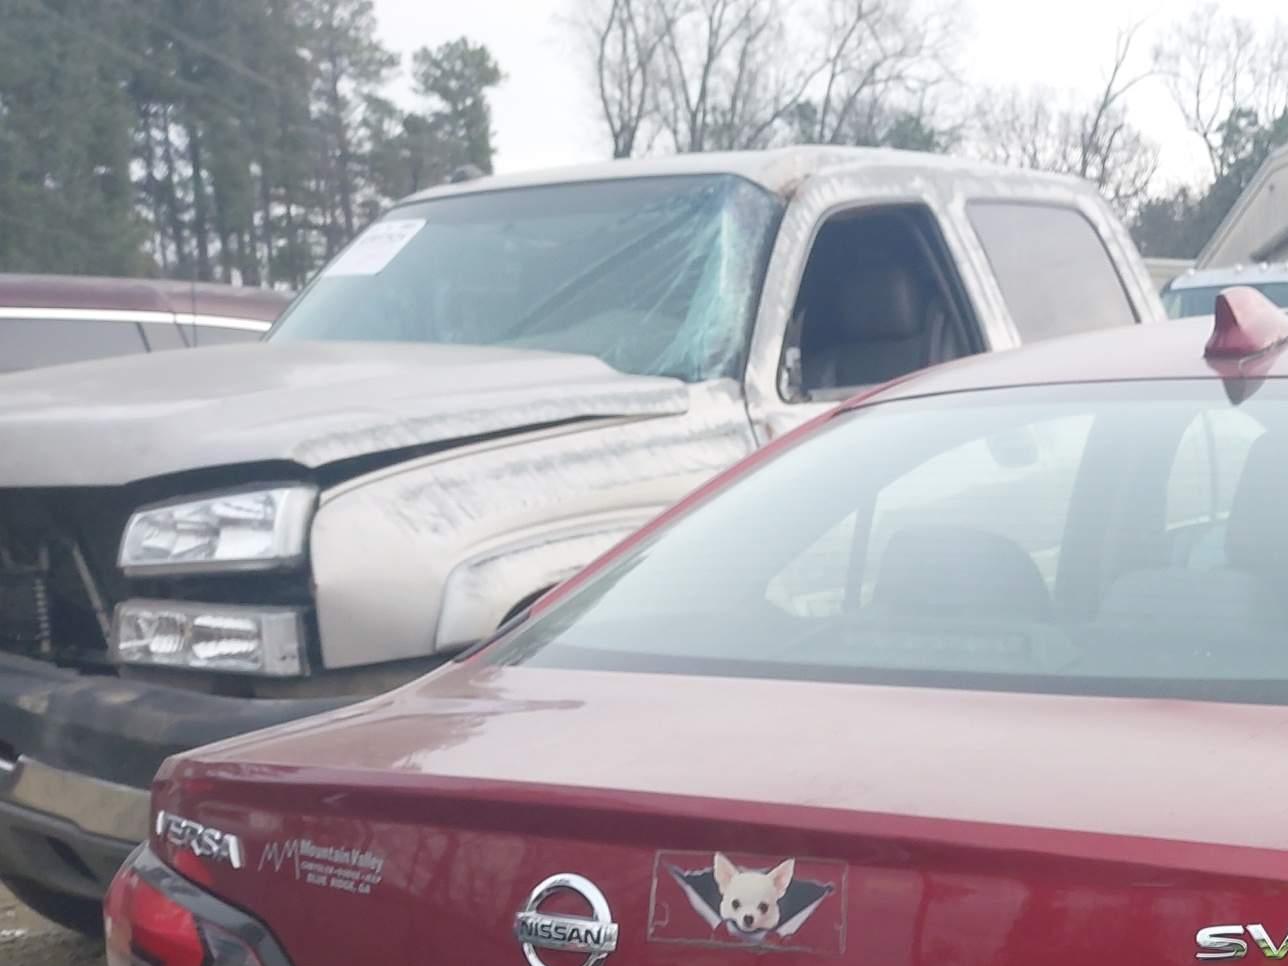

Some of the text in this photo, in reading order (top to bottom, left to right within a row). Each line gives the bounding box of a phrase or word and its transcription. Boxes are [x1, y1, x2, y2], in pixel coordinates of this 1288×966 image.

[155, 810, 243, 869] VERSA
[299, 839, 350, 864] Mountain
[351, 848, 385, 873] Valley
[519, 919, 602, 945] NISSAN
